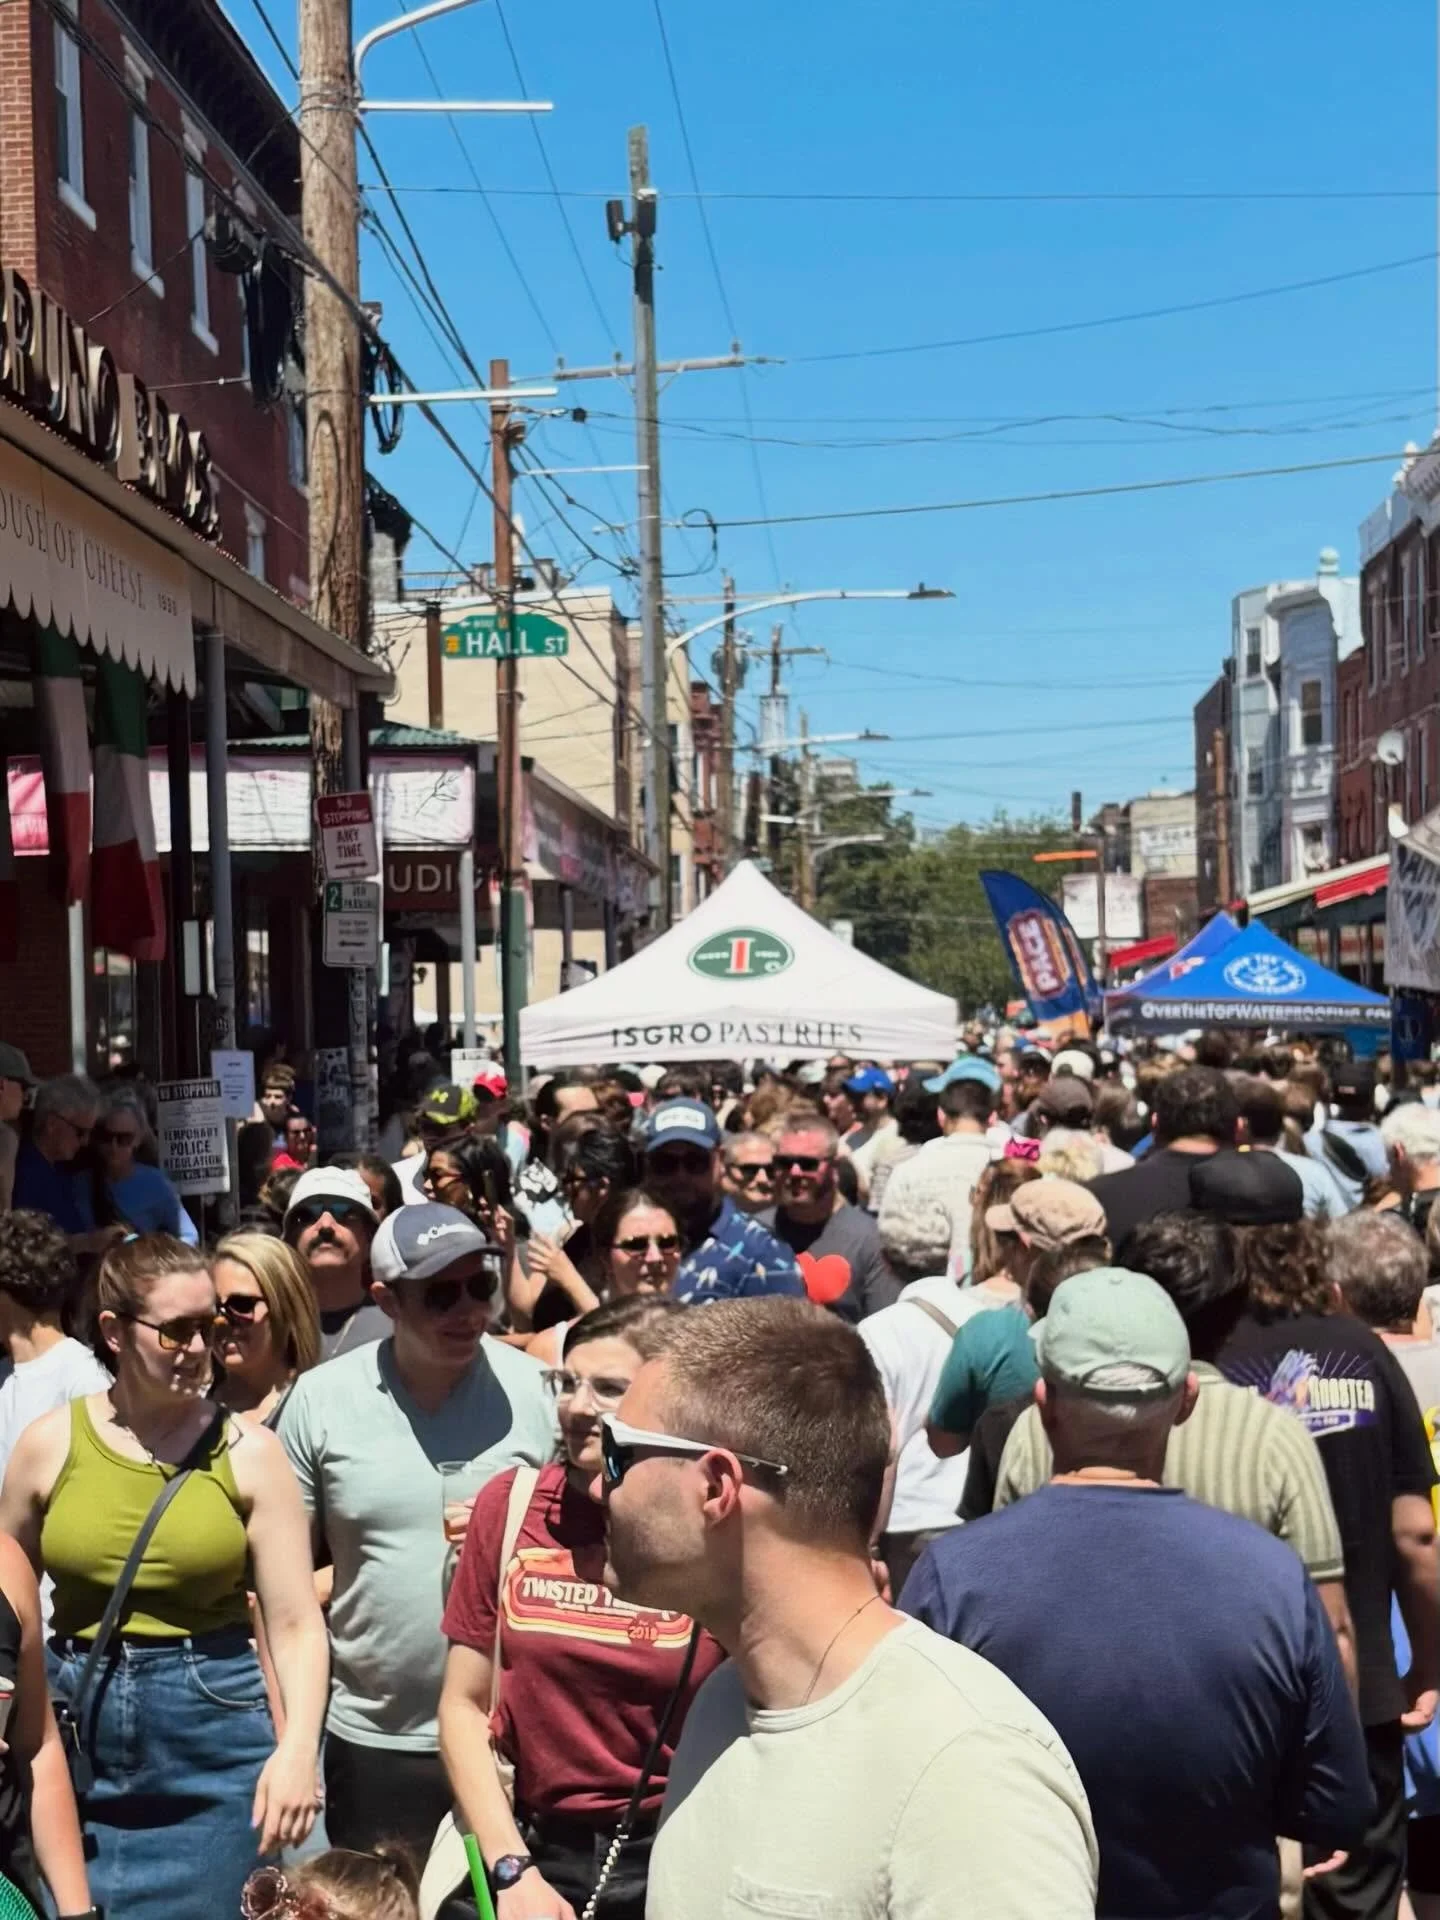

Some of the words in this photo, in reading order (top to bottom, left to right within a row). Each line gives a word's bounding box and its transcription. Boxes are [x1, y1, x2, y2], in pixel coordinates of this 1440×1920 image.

[0, 268, 119, 463] RUNO
[54, 521, 77, 569] OF
[466, 631, 534, 655] HALL
[544, 636, 566, 653] ST
[322, 808, 370, 825] STOPPING
[336, 829, 360, 843] ANY
[336, 843, 364, 859] TIME
[329, 886, 339, 908] 2
[611, 1023, 711, 1047] ISGRO
[719, 1021, 862, 1047] PASTRIES
[173, 1081, 219, 1097] STOPPING
[164, 1127, 219, 1141] TEMPORARY
[169, 1140, 212, 1156] POLICE
[522, 1577, 599, 1605] TWISTED
